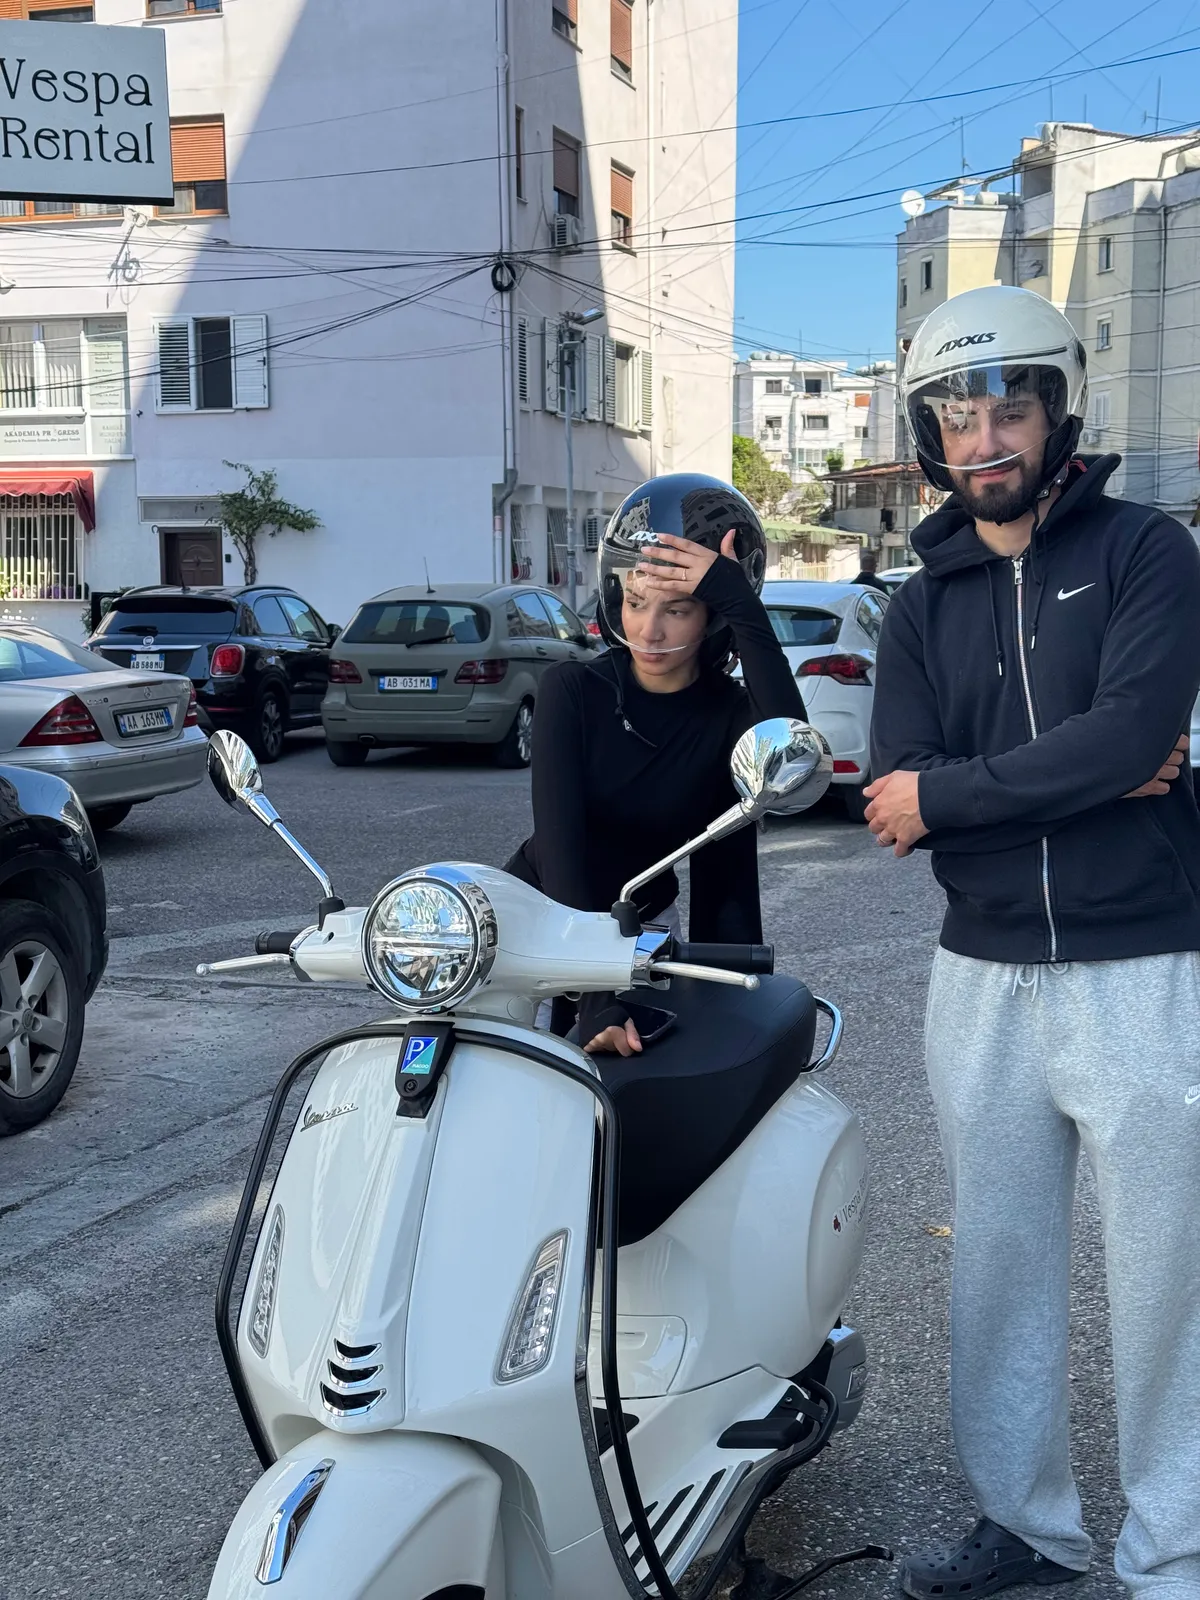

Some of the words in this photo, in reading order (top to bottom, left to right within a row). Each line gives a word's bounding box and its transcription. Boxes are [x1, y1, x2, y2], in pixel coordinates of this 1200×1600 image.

[0, 57, 153, 117] Vespa
[0, 115, 155, 164] Rental
[934, 332, 998, 357] AXXIS
